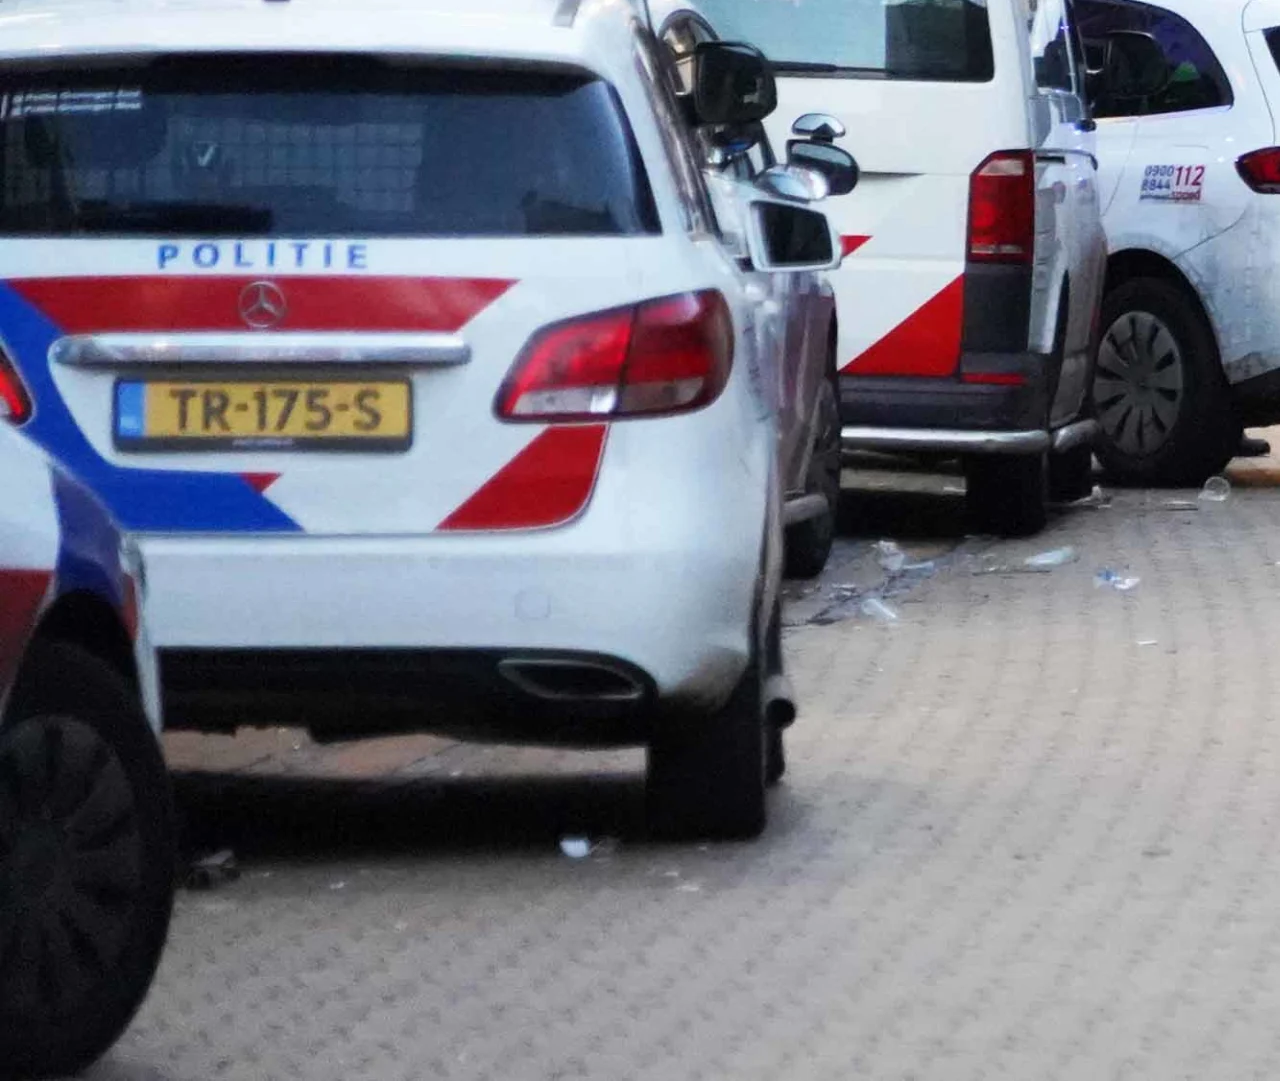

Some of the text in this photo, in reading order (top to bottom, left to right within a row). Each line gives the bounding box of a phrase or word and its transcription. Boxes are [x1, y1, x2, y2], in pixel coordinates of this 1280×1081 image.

[1175, 165, 1205, 186] 112
[157, 243, 368, 269] POLITIE
[169, 388, 382, 431] TR-175-S
